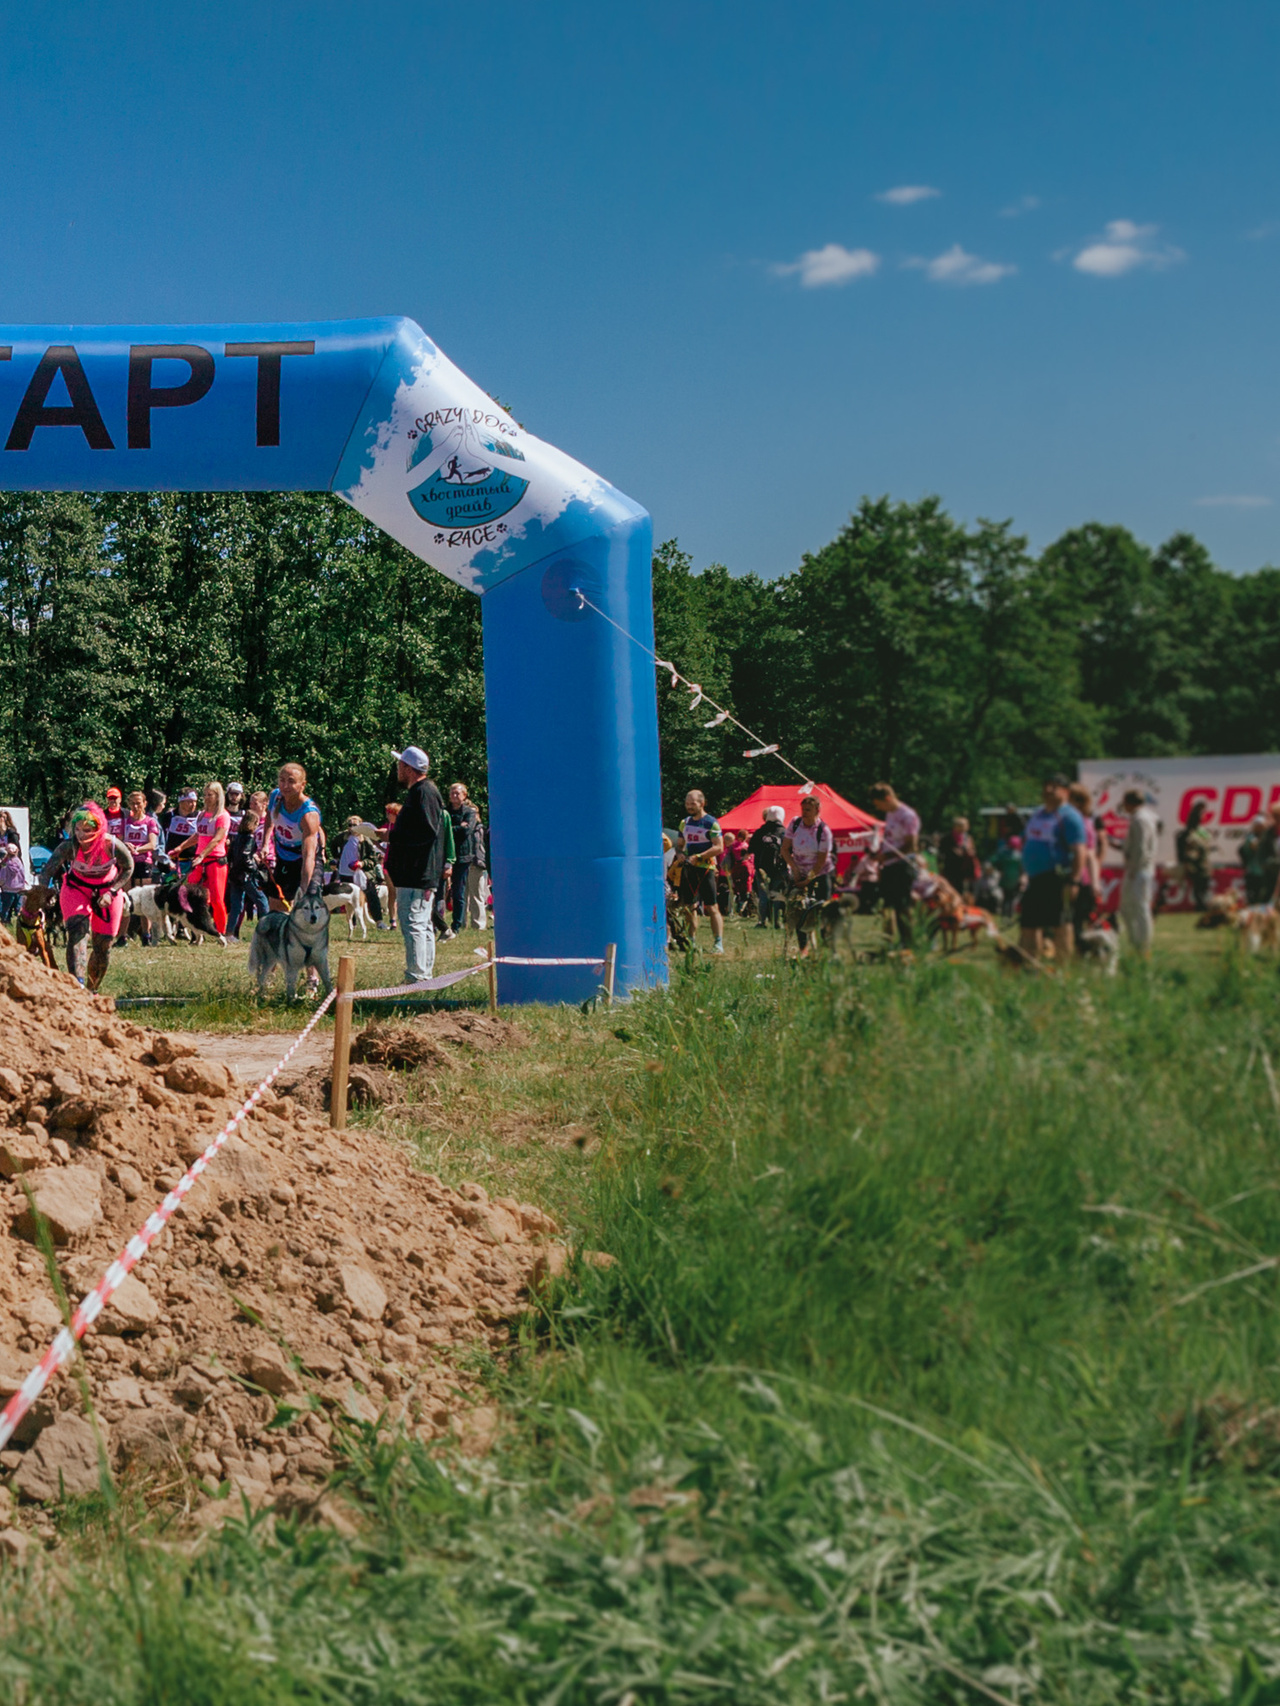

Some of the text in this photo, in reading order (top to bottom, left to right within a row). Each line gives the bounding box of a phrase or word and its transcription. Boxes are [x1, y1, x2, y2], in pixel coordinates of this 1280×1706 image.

[416, 407, 510, 433] CRAZY DOG
[421, 481, 512, 503] хвостатый
[446, 498, 491, 521] драйв
[447, 525, 497, 548] RACE
